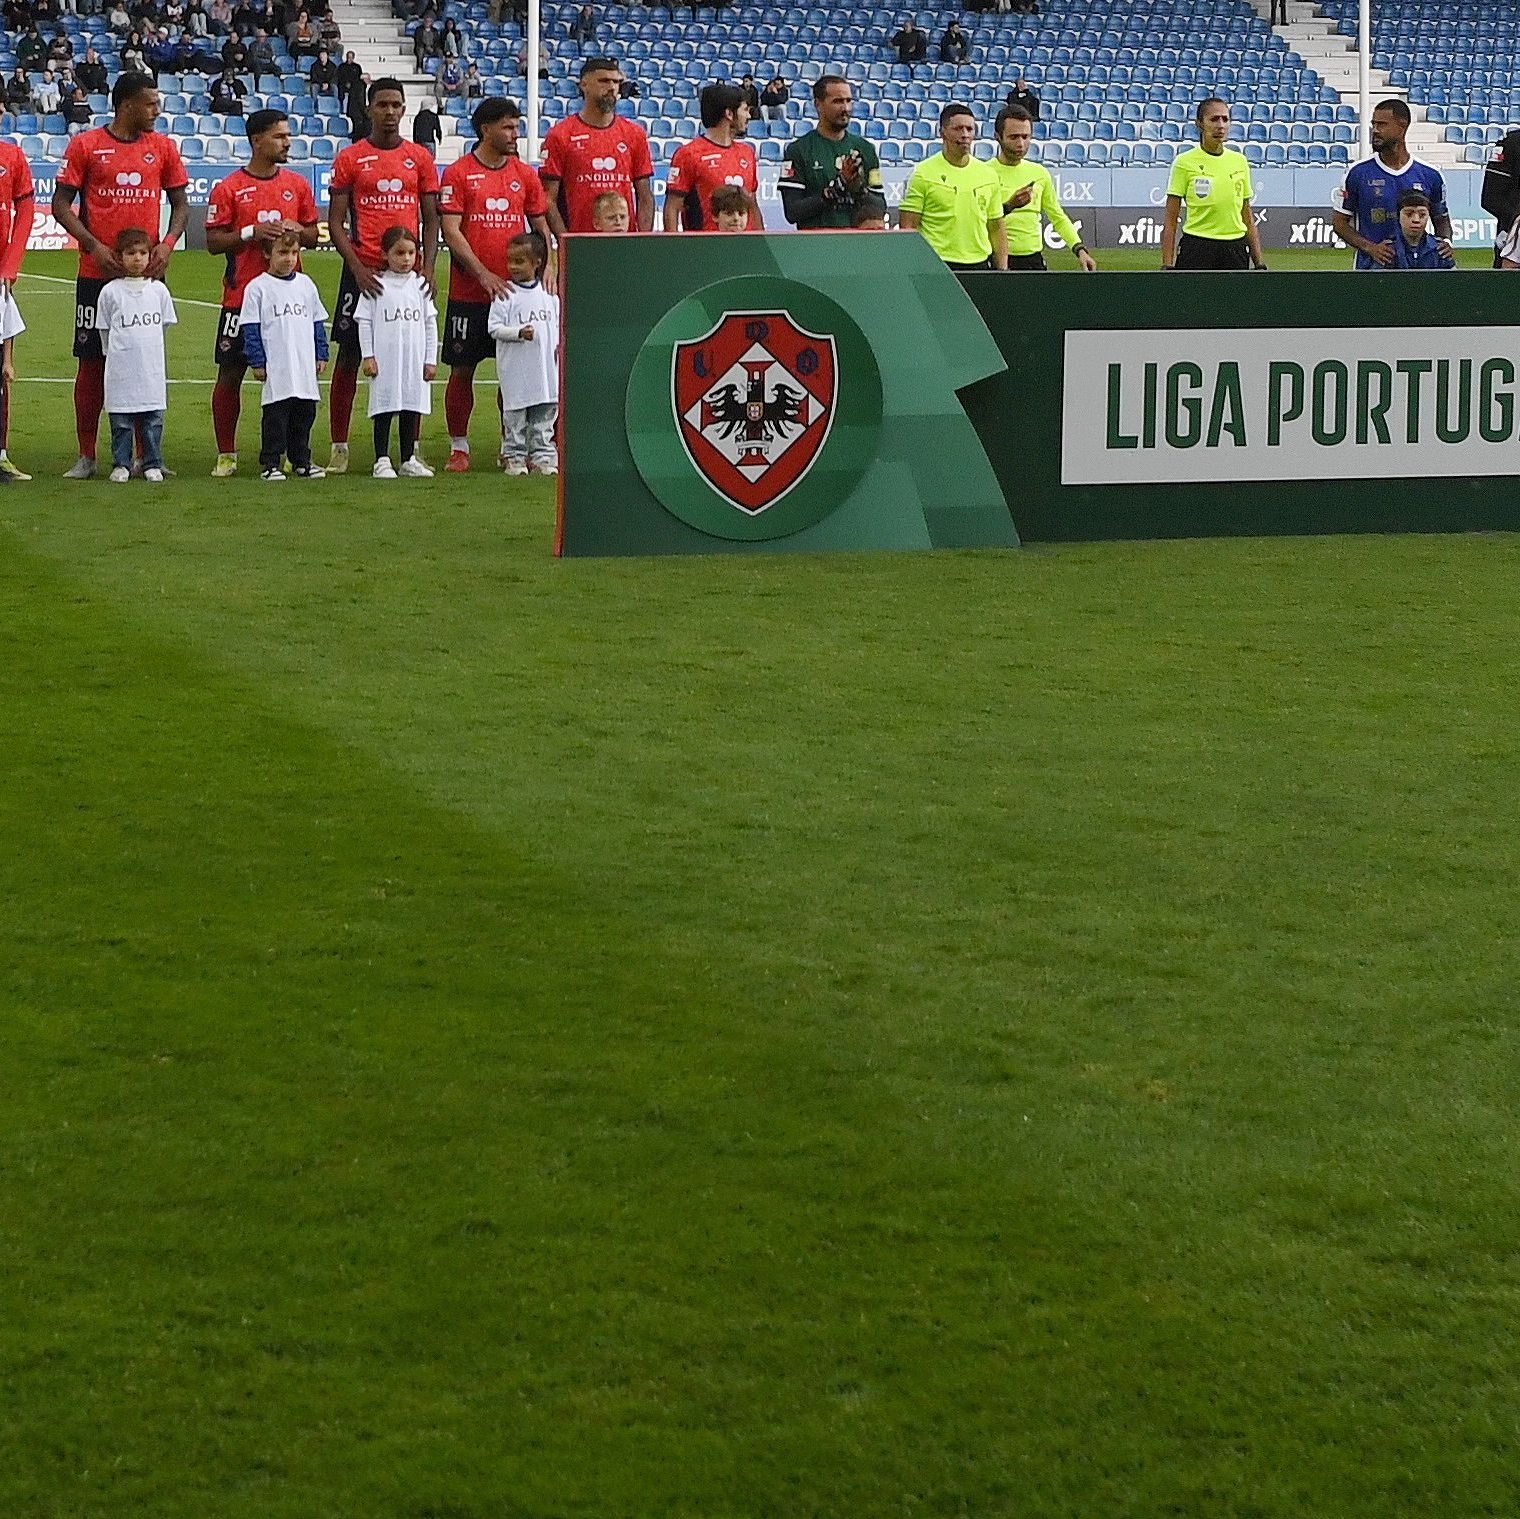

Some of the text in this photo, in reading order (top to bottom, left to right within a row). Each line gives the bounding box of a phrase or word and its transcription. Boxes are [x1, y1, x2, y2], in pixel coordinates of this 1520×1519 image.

[576, 172, 631, 183] ONODERA
[98, 187, 156, 199] ONODERA
[469, 213, 522, 224] ONODERA
[1118, 216, 1164, 245] xfin
[1289, 216, 1339, 245] xfin
[76, 304, 95, 330] 99
[273, 302, 308, 318] LAGO
[342, 292, 353, 317] 2
[384, 308, 420, 323] LAGO
[120, 312, 161, 329] LAGO
[222, 311, 240, 338] 19
[452, 315, 468, 340] 14
[1106, 361, 1247, 450] LIGA
